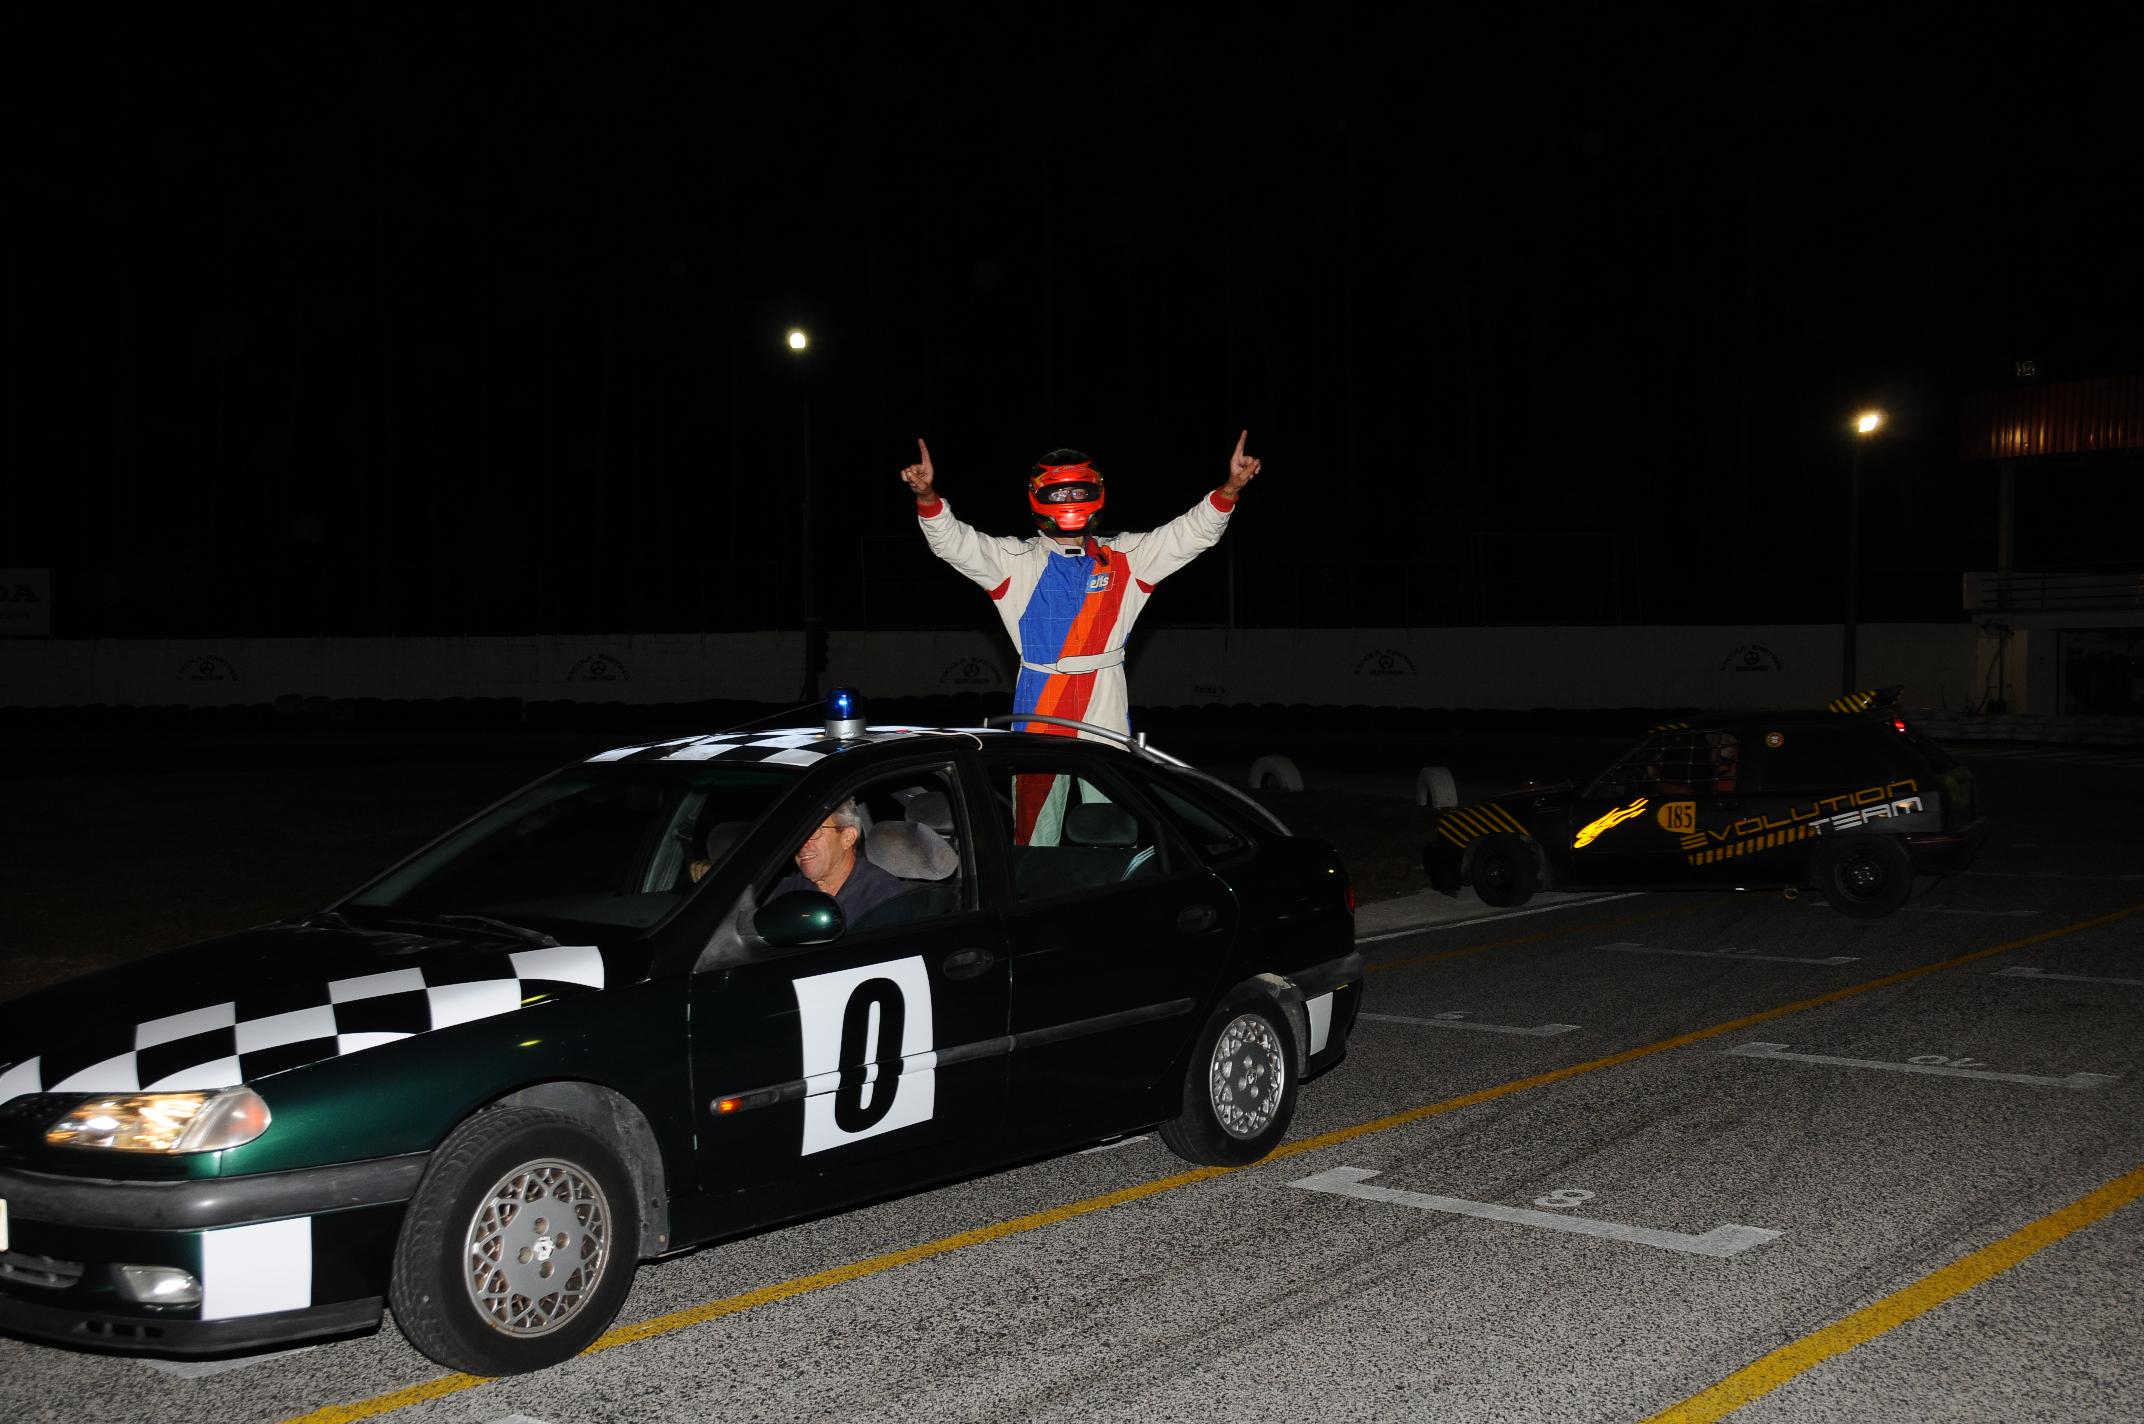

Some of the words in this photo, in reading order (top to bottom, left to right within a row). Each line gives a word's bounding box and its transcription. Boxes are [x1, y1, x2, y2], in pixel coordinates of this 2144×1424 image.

[1667, 805, 1693, 829] 185
[1680, 778, 1918, 850] EVOLUTION
[1808, 796, 1924, 836] TEAM
[834, 977, 906, 1134] 0
[1534, 1189, 1596, 1208] 8
